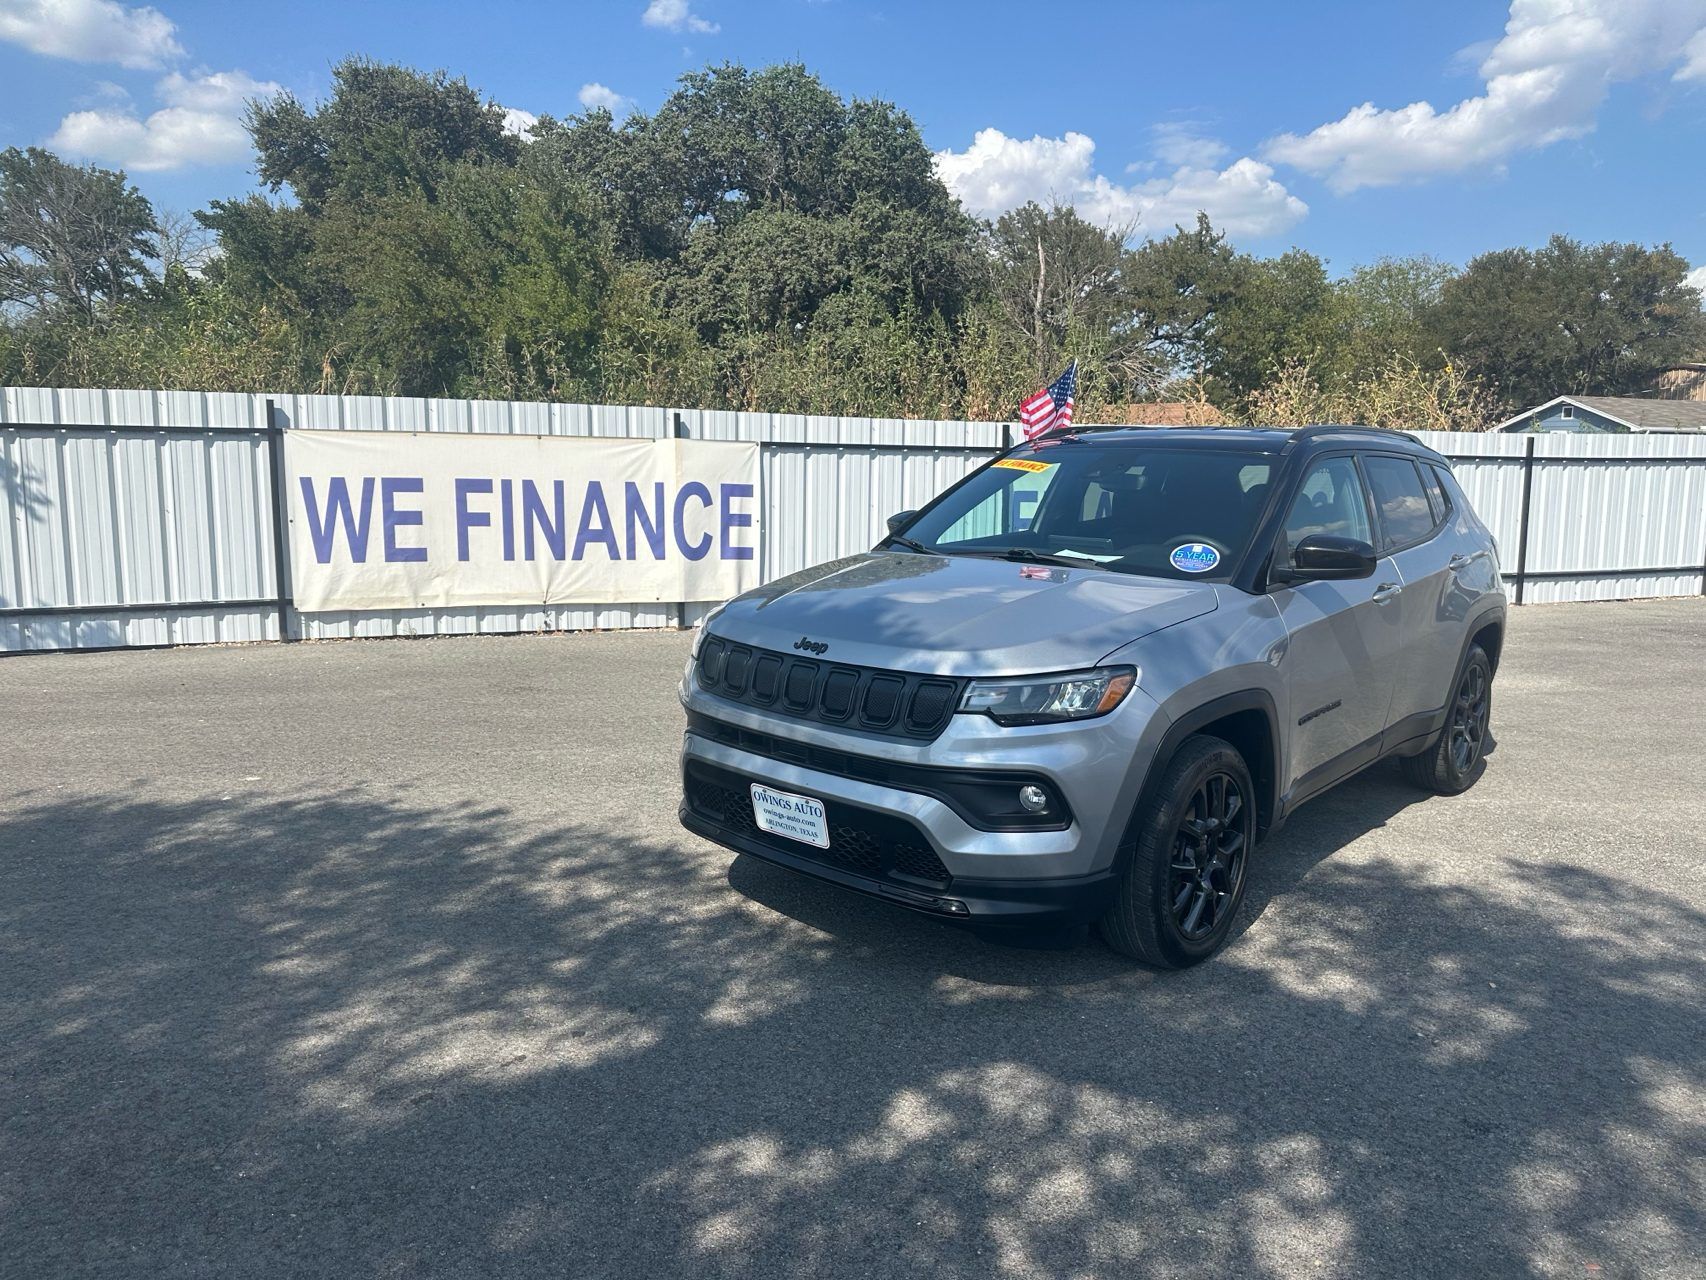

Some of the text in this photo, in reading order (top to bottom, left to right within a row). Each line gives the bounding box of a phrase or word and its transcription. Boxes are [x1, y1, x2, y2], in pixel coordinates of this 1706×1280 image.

[299, 476, 754, 564] WE FINANCE
[1175, 550, 1185, 558] 5
[1186, 551, 1215, 561] YEAR
[793, 636, 829, 655] Jeep
[753, 790, 823, 818] OWINGS AUTO
[763, 807, 816, 828] owings-auto.com
[799, 827, 819, 838] TEXAS
